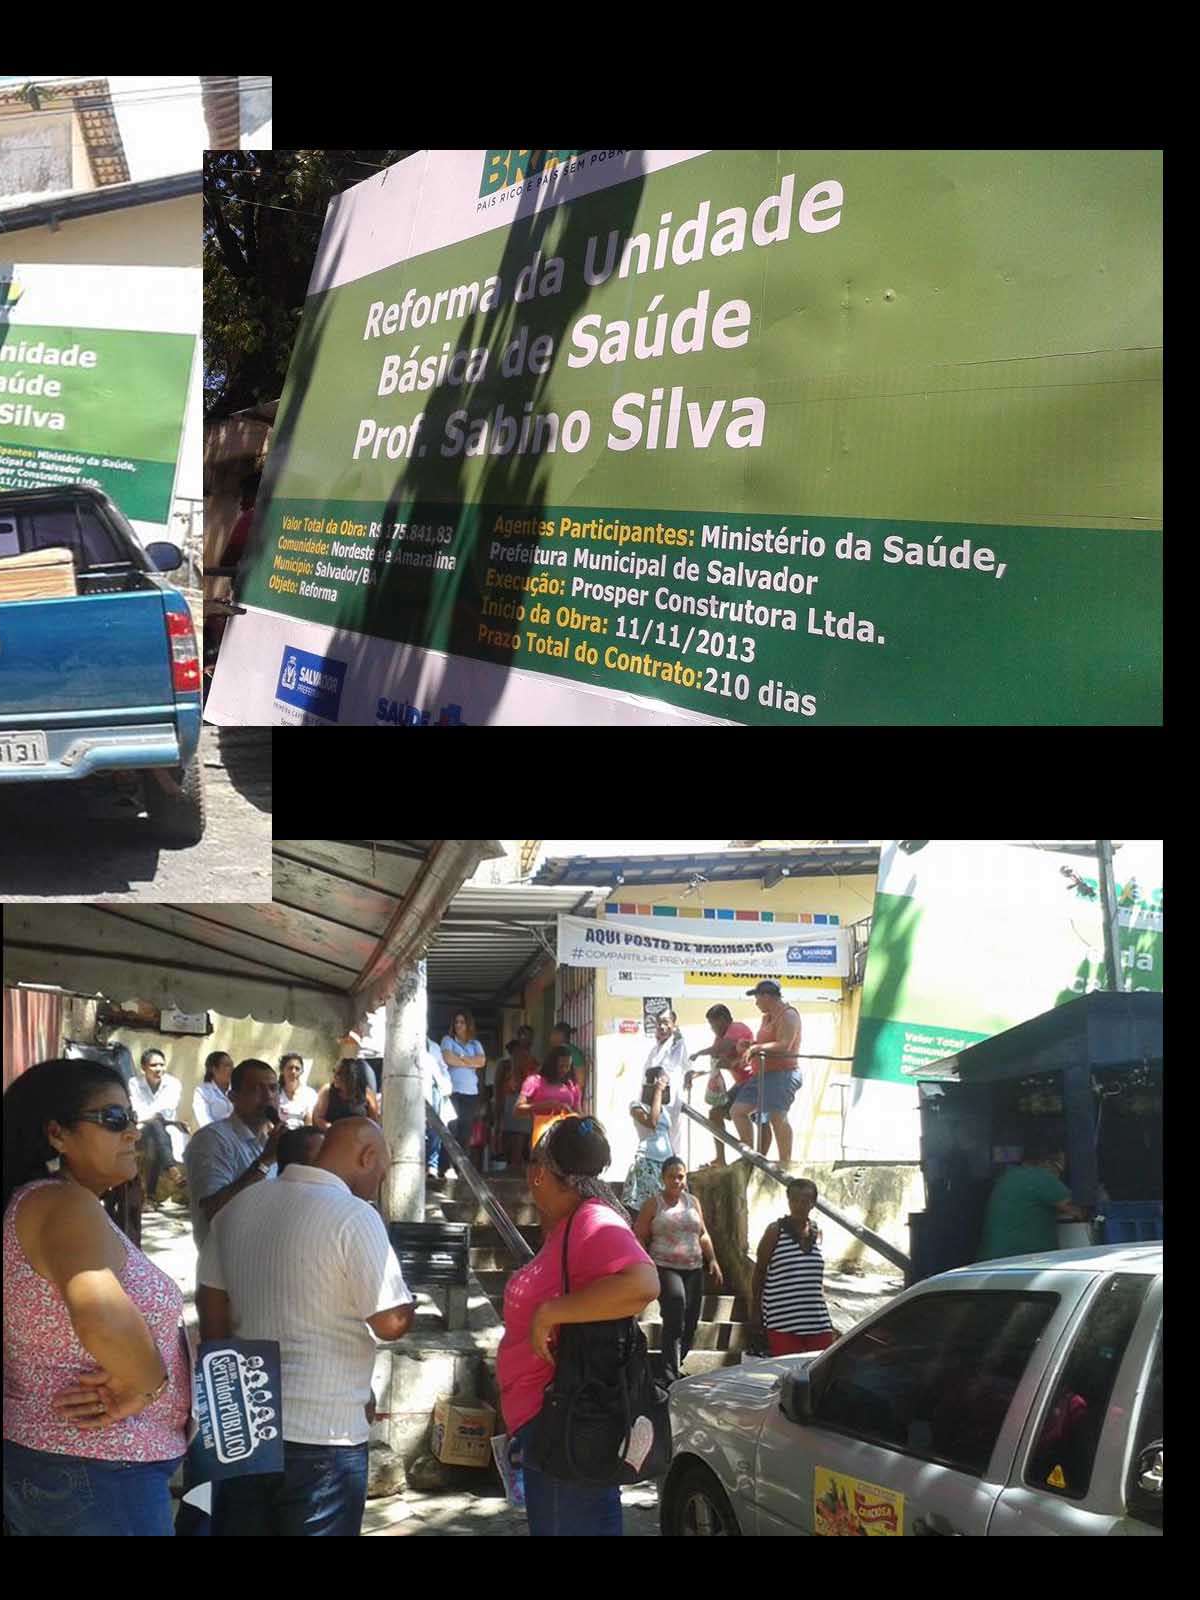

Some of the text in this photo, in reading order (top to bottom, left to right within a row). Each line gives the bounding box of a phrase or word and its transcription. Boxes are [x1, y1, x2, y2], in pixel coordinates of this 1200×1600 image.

[499, 185, 523, 204] RICO
[563, 160, 586, 177] SEM
[363, 274, 501, 341] Reforma
[514, 250, 565, 303] da
[583, 173, 845, 288] Unidade
[377, 290, 752, 397] Básica de Saúde
[352, 386, 767, 461] Prof. Sabino Silva
[278, 536, 457, 570] Comunidade: Nordeste de Amaralina
[282, 516, 302, 531] Valor
[304, 517, 324, 534] Total
[326, 520, 338, 534] da
[340, 520, 367, 537] Obra:
[494, 515, 1008, 579] Agentes Participantes: Ministério da Saúde,
[269, 574, 338, 602] Objeto: Reforma
[490, 541, 819, 596] Prefeitura Municipal de Salvador
[480, 595, 756, 664] Início da Obra: 11/11/2013
[485, 567, 886, 645] Execução: Prosper Construtora Ltda.
[477, 623, 522, 650] Prazo
[526, 632, 570, 659] Total
[574, 641, 598, 666] do
[757, 680, 817, 717] dias
[585, 928, 620, 946] AQUI
[623, 933, 671, 951] POSTO
